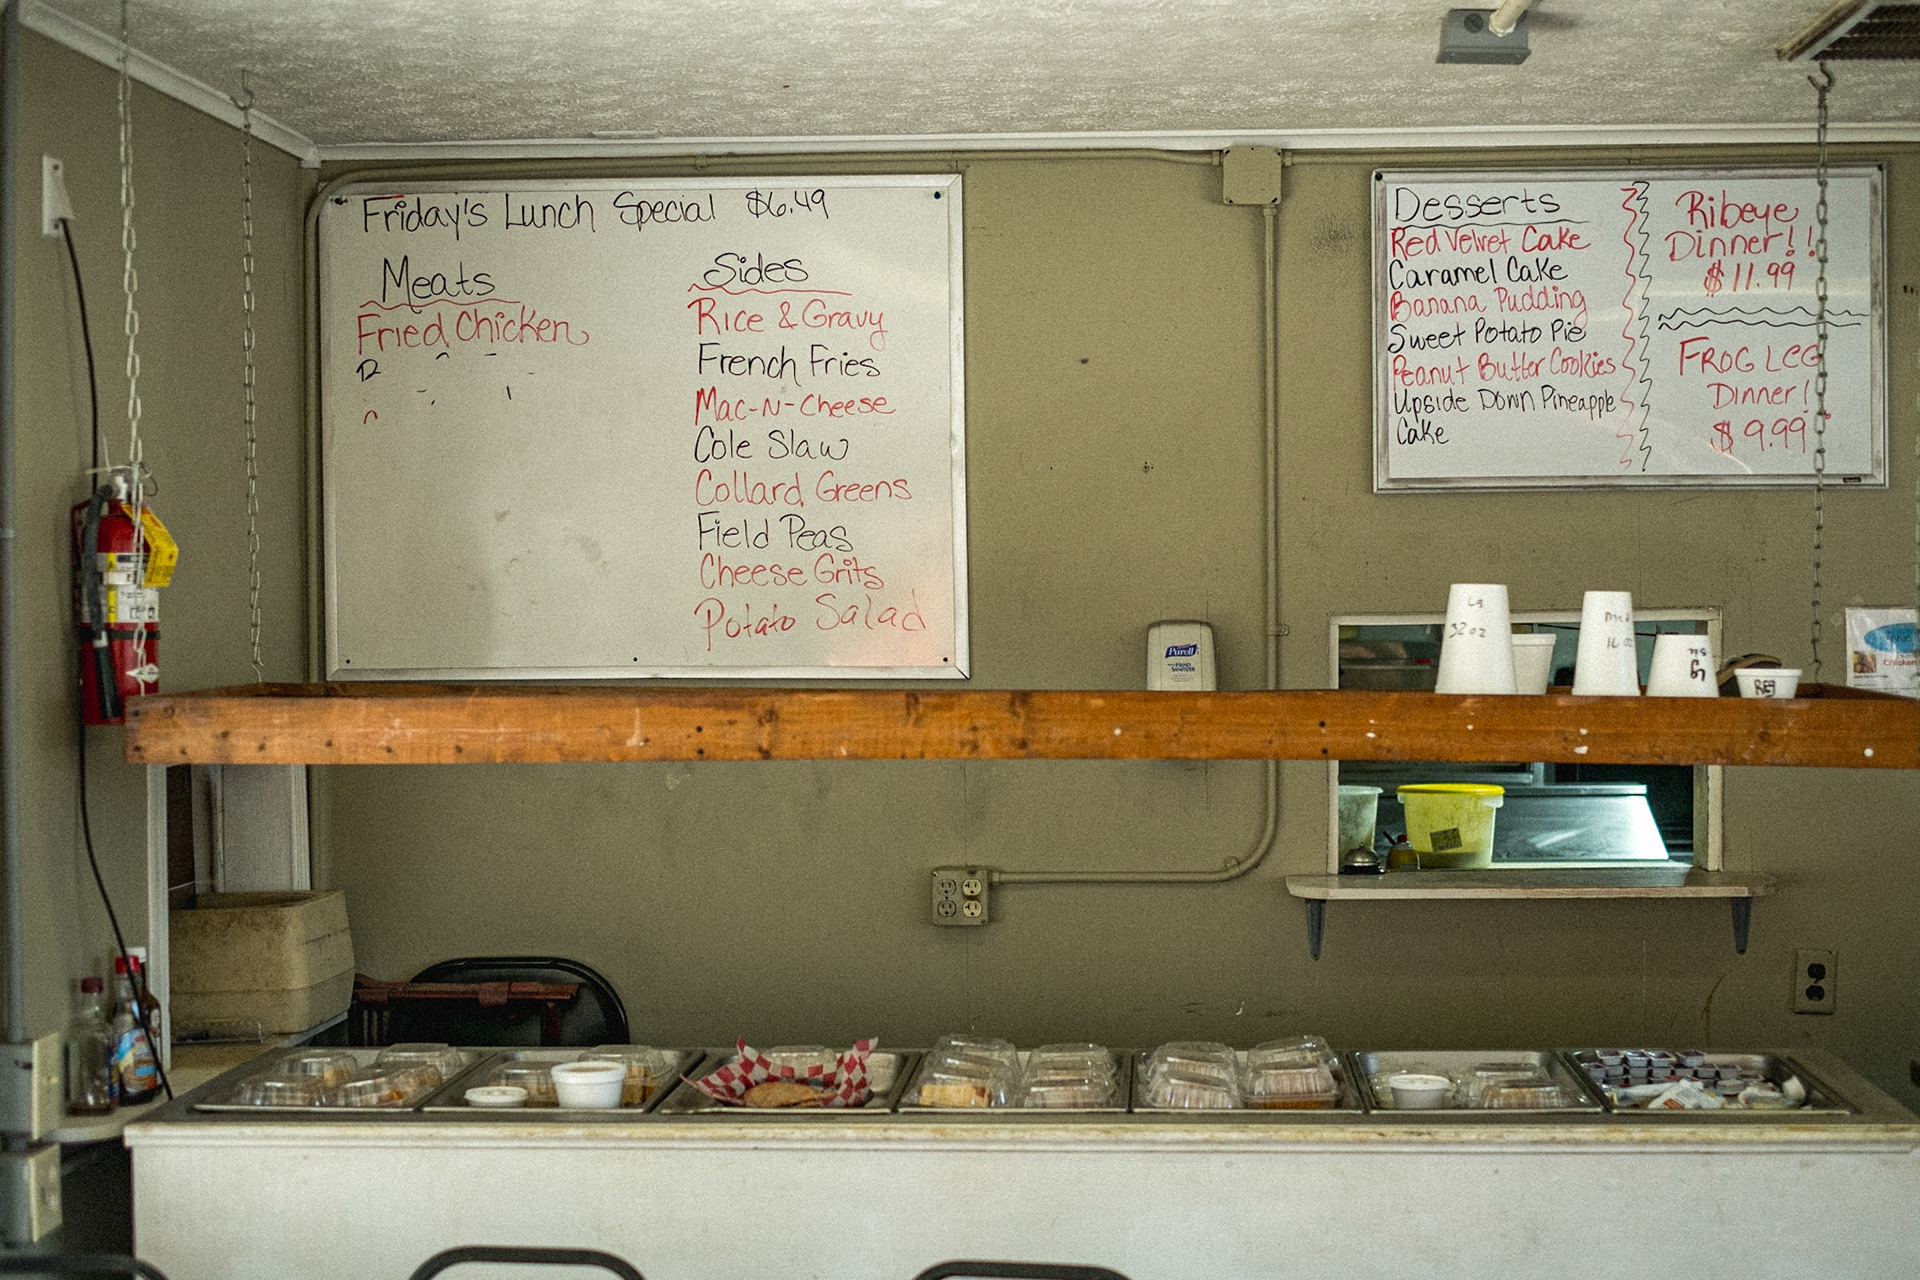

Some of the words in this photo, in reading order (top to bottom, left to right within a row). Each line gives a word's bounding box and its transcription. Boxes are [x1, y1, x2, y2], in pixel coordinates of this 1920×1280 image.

[363, 194, 488, 241] Friday's
[505, 193, 596, 233] Lunch
[613, 191, 716, 231] Special
[745, 188, 829, 219] $6.49
[1394, 187, 1561, 222] Desserts
[1675, 190, 1799, 236] Ribeye
[1391, 226, 1441, 261] Red
[1445, 226, 1511, 254] Velvet
[1521, 225, 1591, 253] Cake
[1664, 225, 1816, 262] Dinner!!
[382, 255, 496, 314] Meats
[703, 252, 809, 287] Sides
[1389, 258, 1498, 290] Caramel
[1507, 255, 1569, 283] Cake
[687, 296, 765, 335] Rice
[778, 300, 798, 330] &
[801, 298, 888, 351] Gravy
[1390, 290, 1487, 323] Banana
[1494, 285, 1588, 334] Pudding
[357, 312, 449, 355] Fried
[455, 305, 590, 346] Chicken
[1388, 322, 1467, 354] Sweet
[1474, 316, 1543, 344] Potato
[1551, 318, 1588, 343] Pie
[698, 342, 801, 387] French
[809, 343, 882, 378] Fries
[1392, 353, 1470, 391] Peanut
[1477, 350, 1546, 382] Butter
[1549, 346, 1617, 378] Cookies
[1679, 336, 1755, 376] FROG
[694, 385, 896, 426] Mac-N-Cheese
[1394, 387, 1470, 423] Upside
[1477, 388, 1536, 413] Down
[1540, 384, 1617, 421] Pineapple
[694, 425, 754, 463] Cole
[768, 428, 849, 461] Slaw
[1396, 416, 1450, 445] Cake
[695, 468, 805, 507] Collard
[815, 470, 913, 502] Greens
[697, 510, 769, 550] Field
[779, 513, 854, 552] Peas
[700, 552, 808, 589] Cheese
[814, 553, 884, 589] Grits
[693, 597, 796, 651] Potato
[815, 588, 927, 632] Salad
[1168, 647, 1195, 656] Purell
